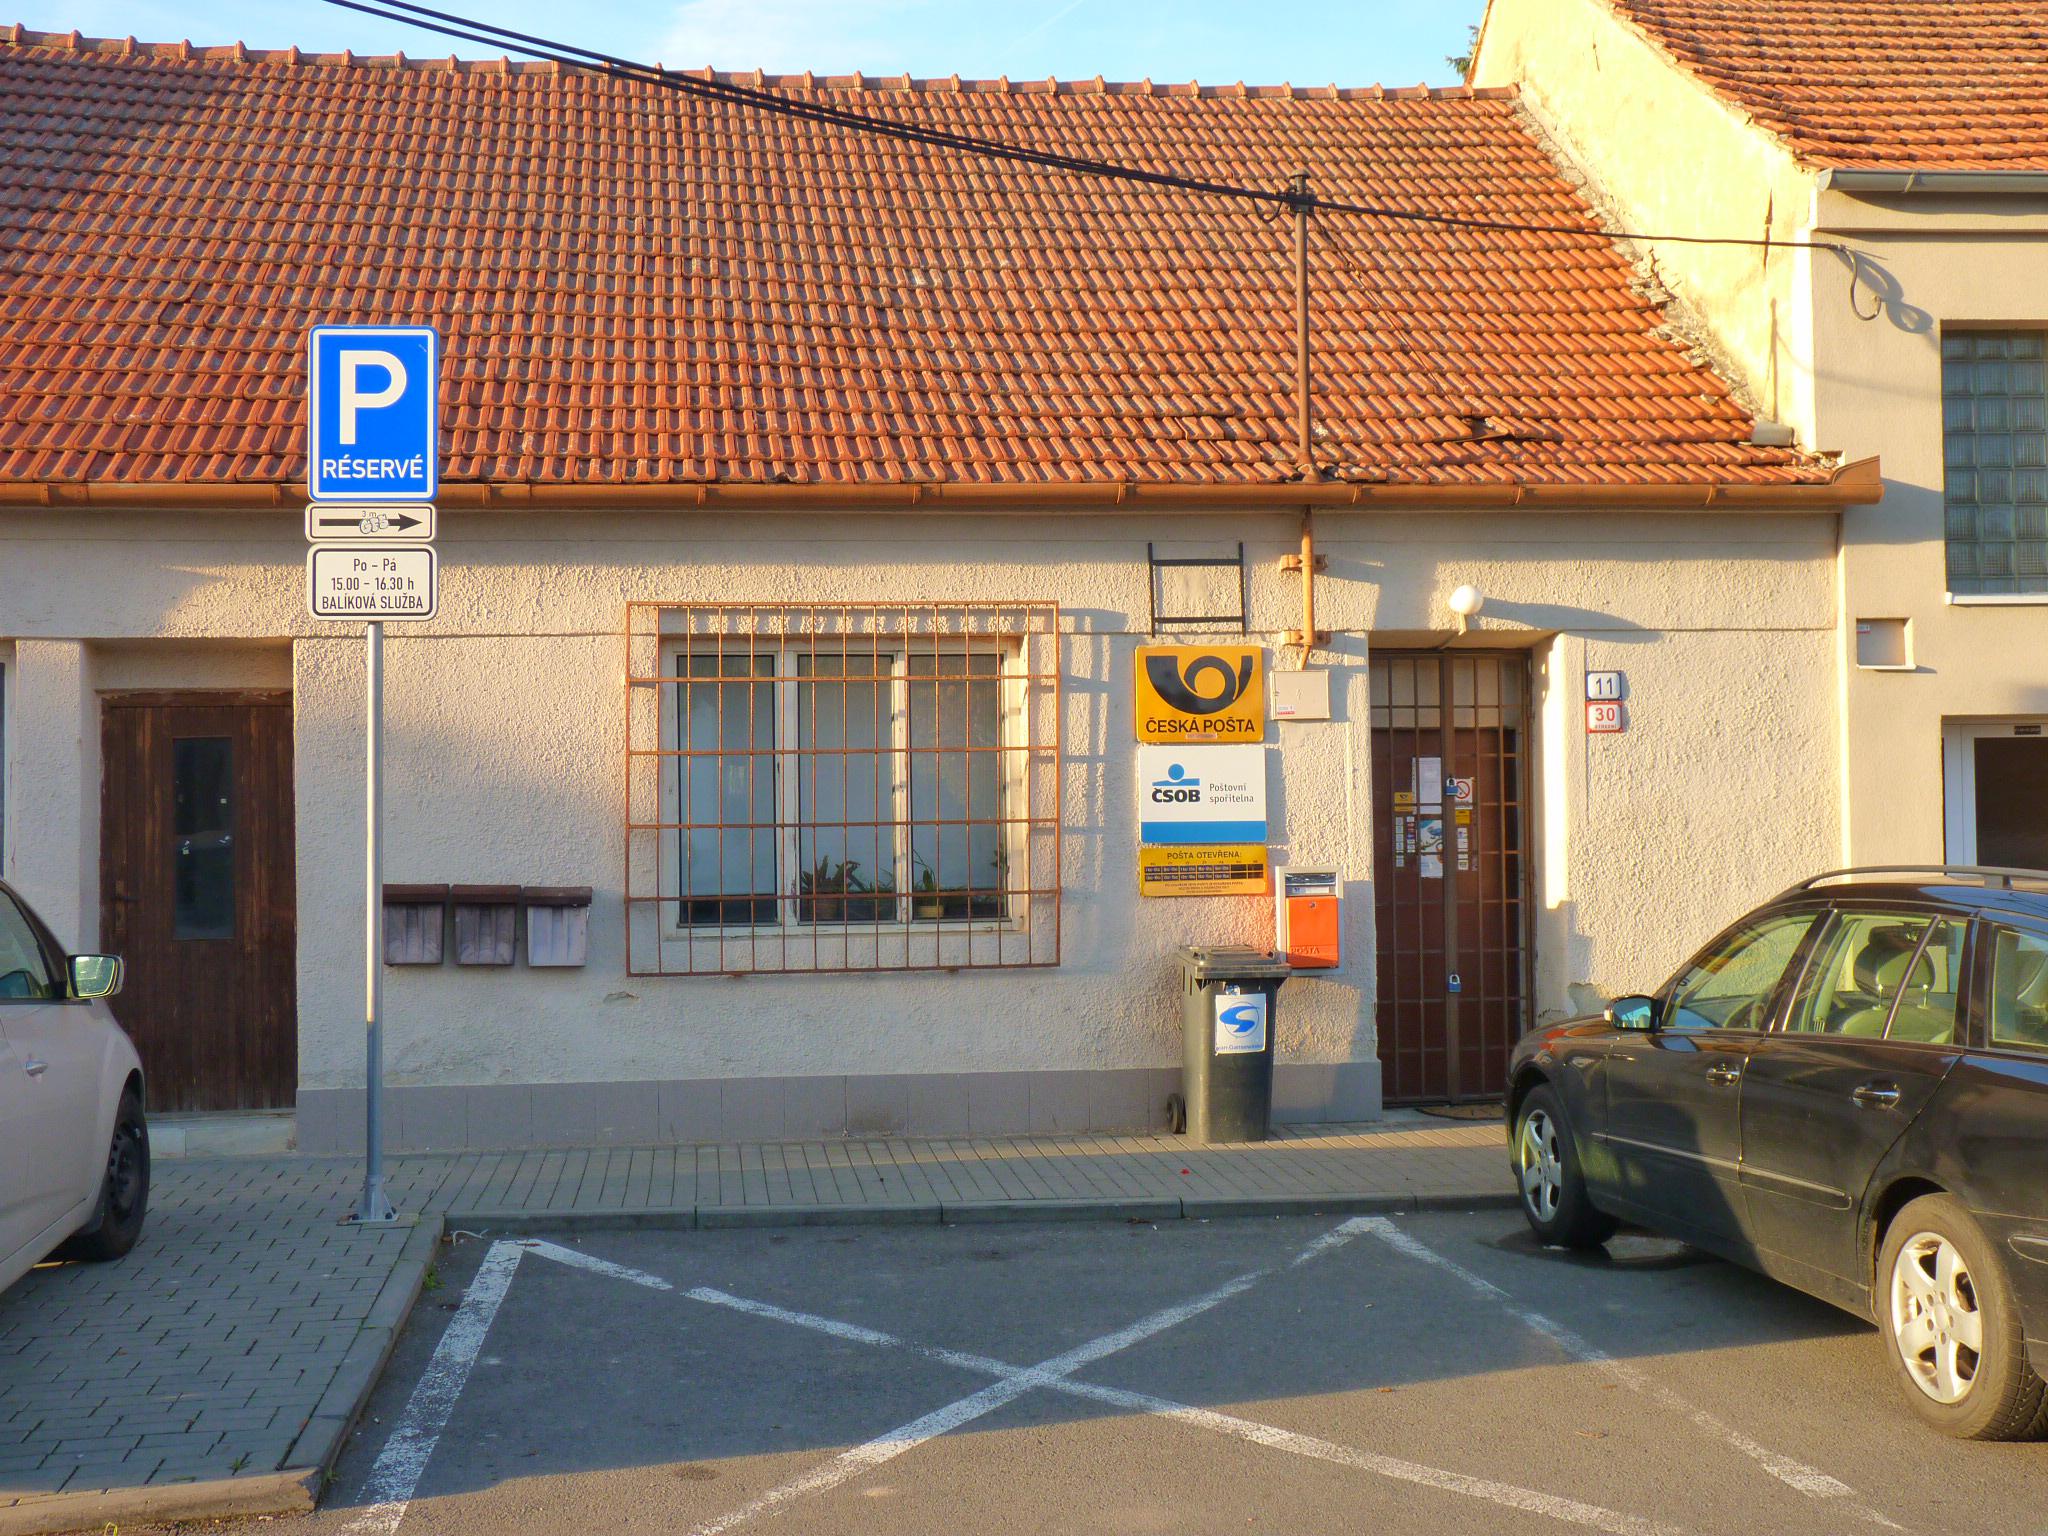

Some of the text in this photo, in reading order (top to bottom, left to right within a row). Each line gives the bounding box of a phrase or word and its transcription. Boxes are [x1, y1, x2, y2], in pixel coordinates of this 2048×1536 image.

[339, 350, 407, 445] P
[322, 454, 424, 479] RÉSERVÉ
[353, 558, 367, 572] Po
[383, 557, 397, 572] Pá
[331, 577, 360, 591] 15.00
[375, 577, 404, 591] 16.30
[407, 577, 415, 590] h
[322, 592, 424, 609] BALÍKOVÁ SLUŽBA
[1596, 677, 1613, 695] 11
[1595, 708, 1615, 722] 30
[1145, 716, 1256, 734] ČESKÁ POŠTA
[1151, 787, 1201, 803] ČSOB
[1209, 782, 1247, 793] Poštovní
[1209, 793, 1254, 805] spořitelna
[1167, 851, 1194, 860] POŠTA
